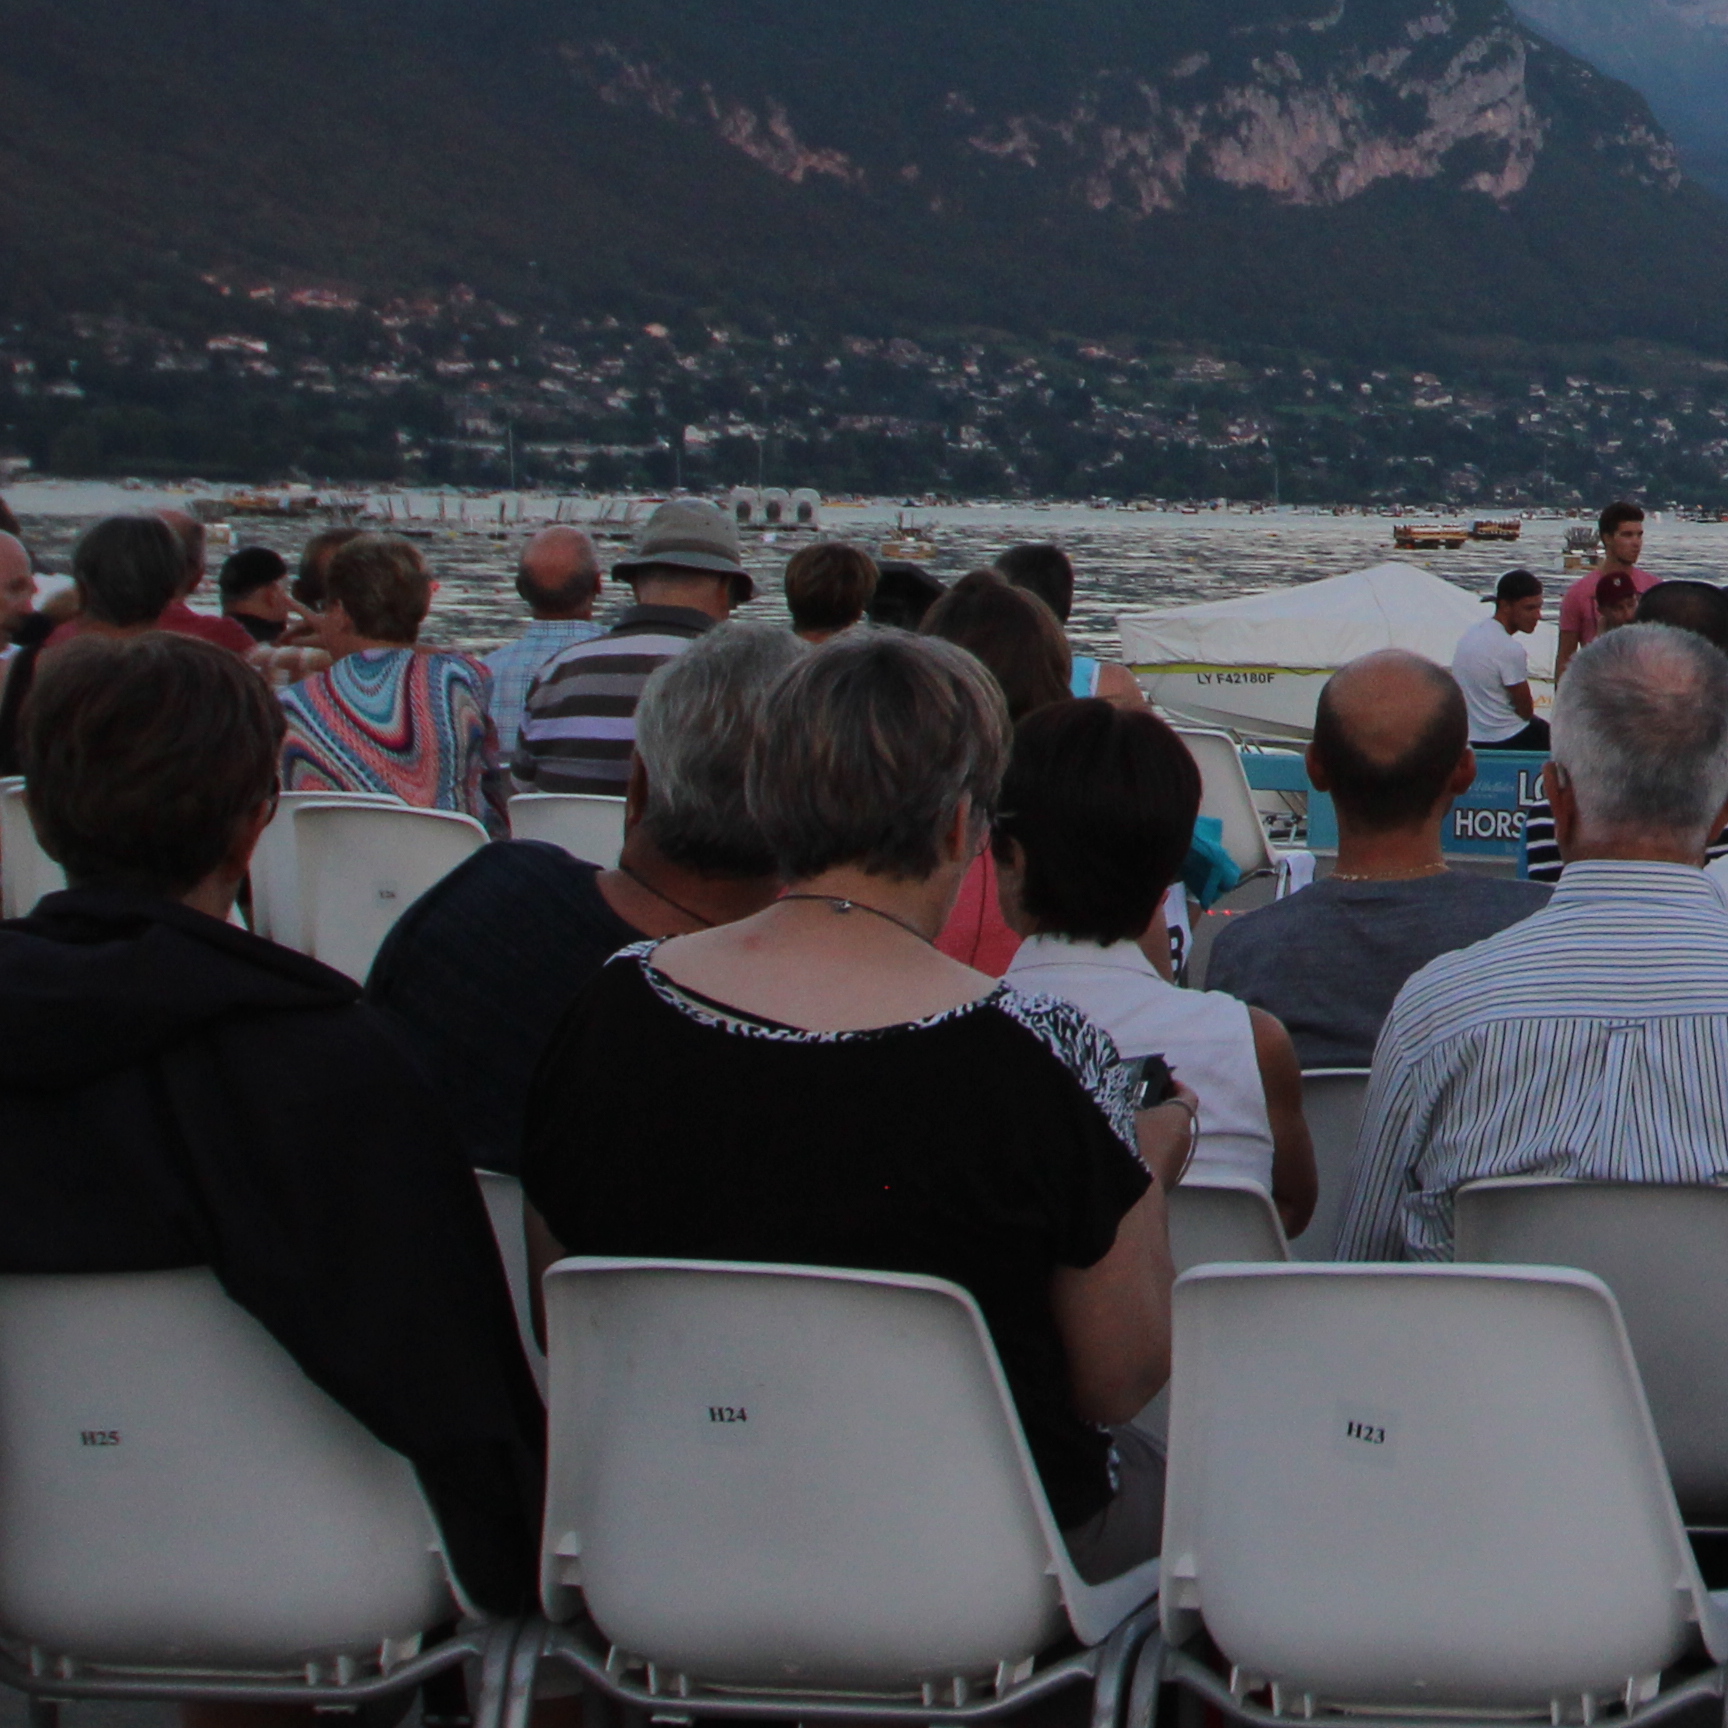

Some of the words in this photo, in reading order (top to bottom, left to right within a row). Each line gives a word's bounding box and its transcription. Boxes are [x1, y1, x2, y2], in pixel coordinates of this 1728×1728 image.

[1197, 673, 1213, 684] LY
[1216, 672, 1275, 684] F42180F
[1455, 810, 1527, 839] HORS
[709, 1406, 747, 1422] H24
[81, 1430, 122, 1446] H25
[1347, 1421, 1386, 1444] H23
